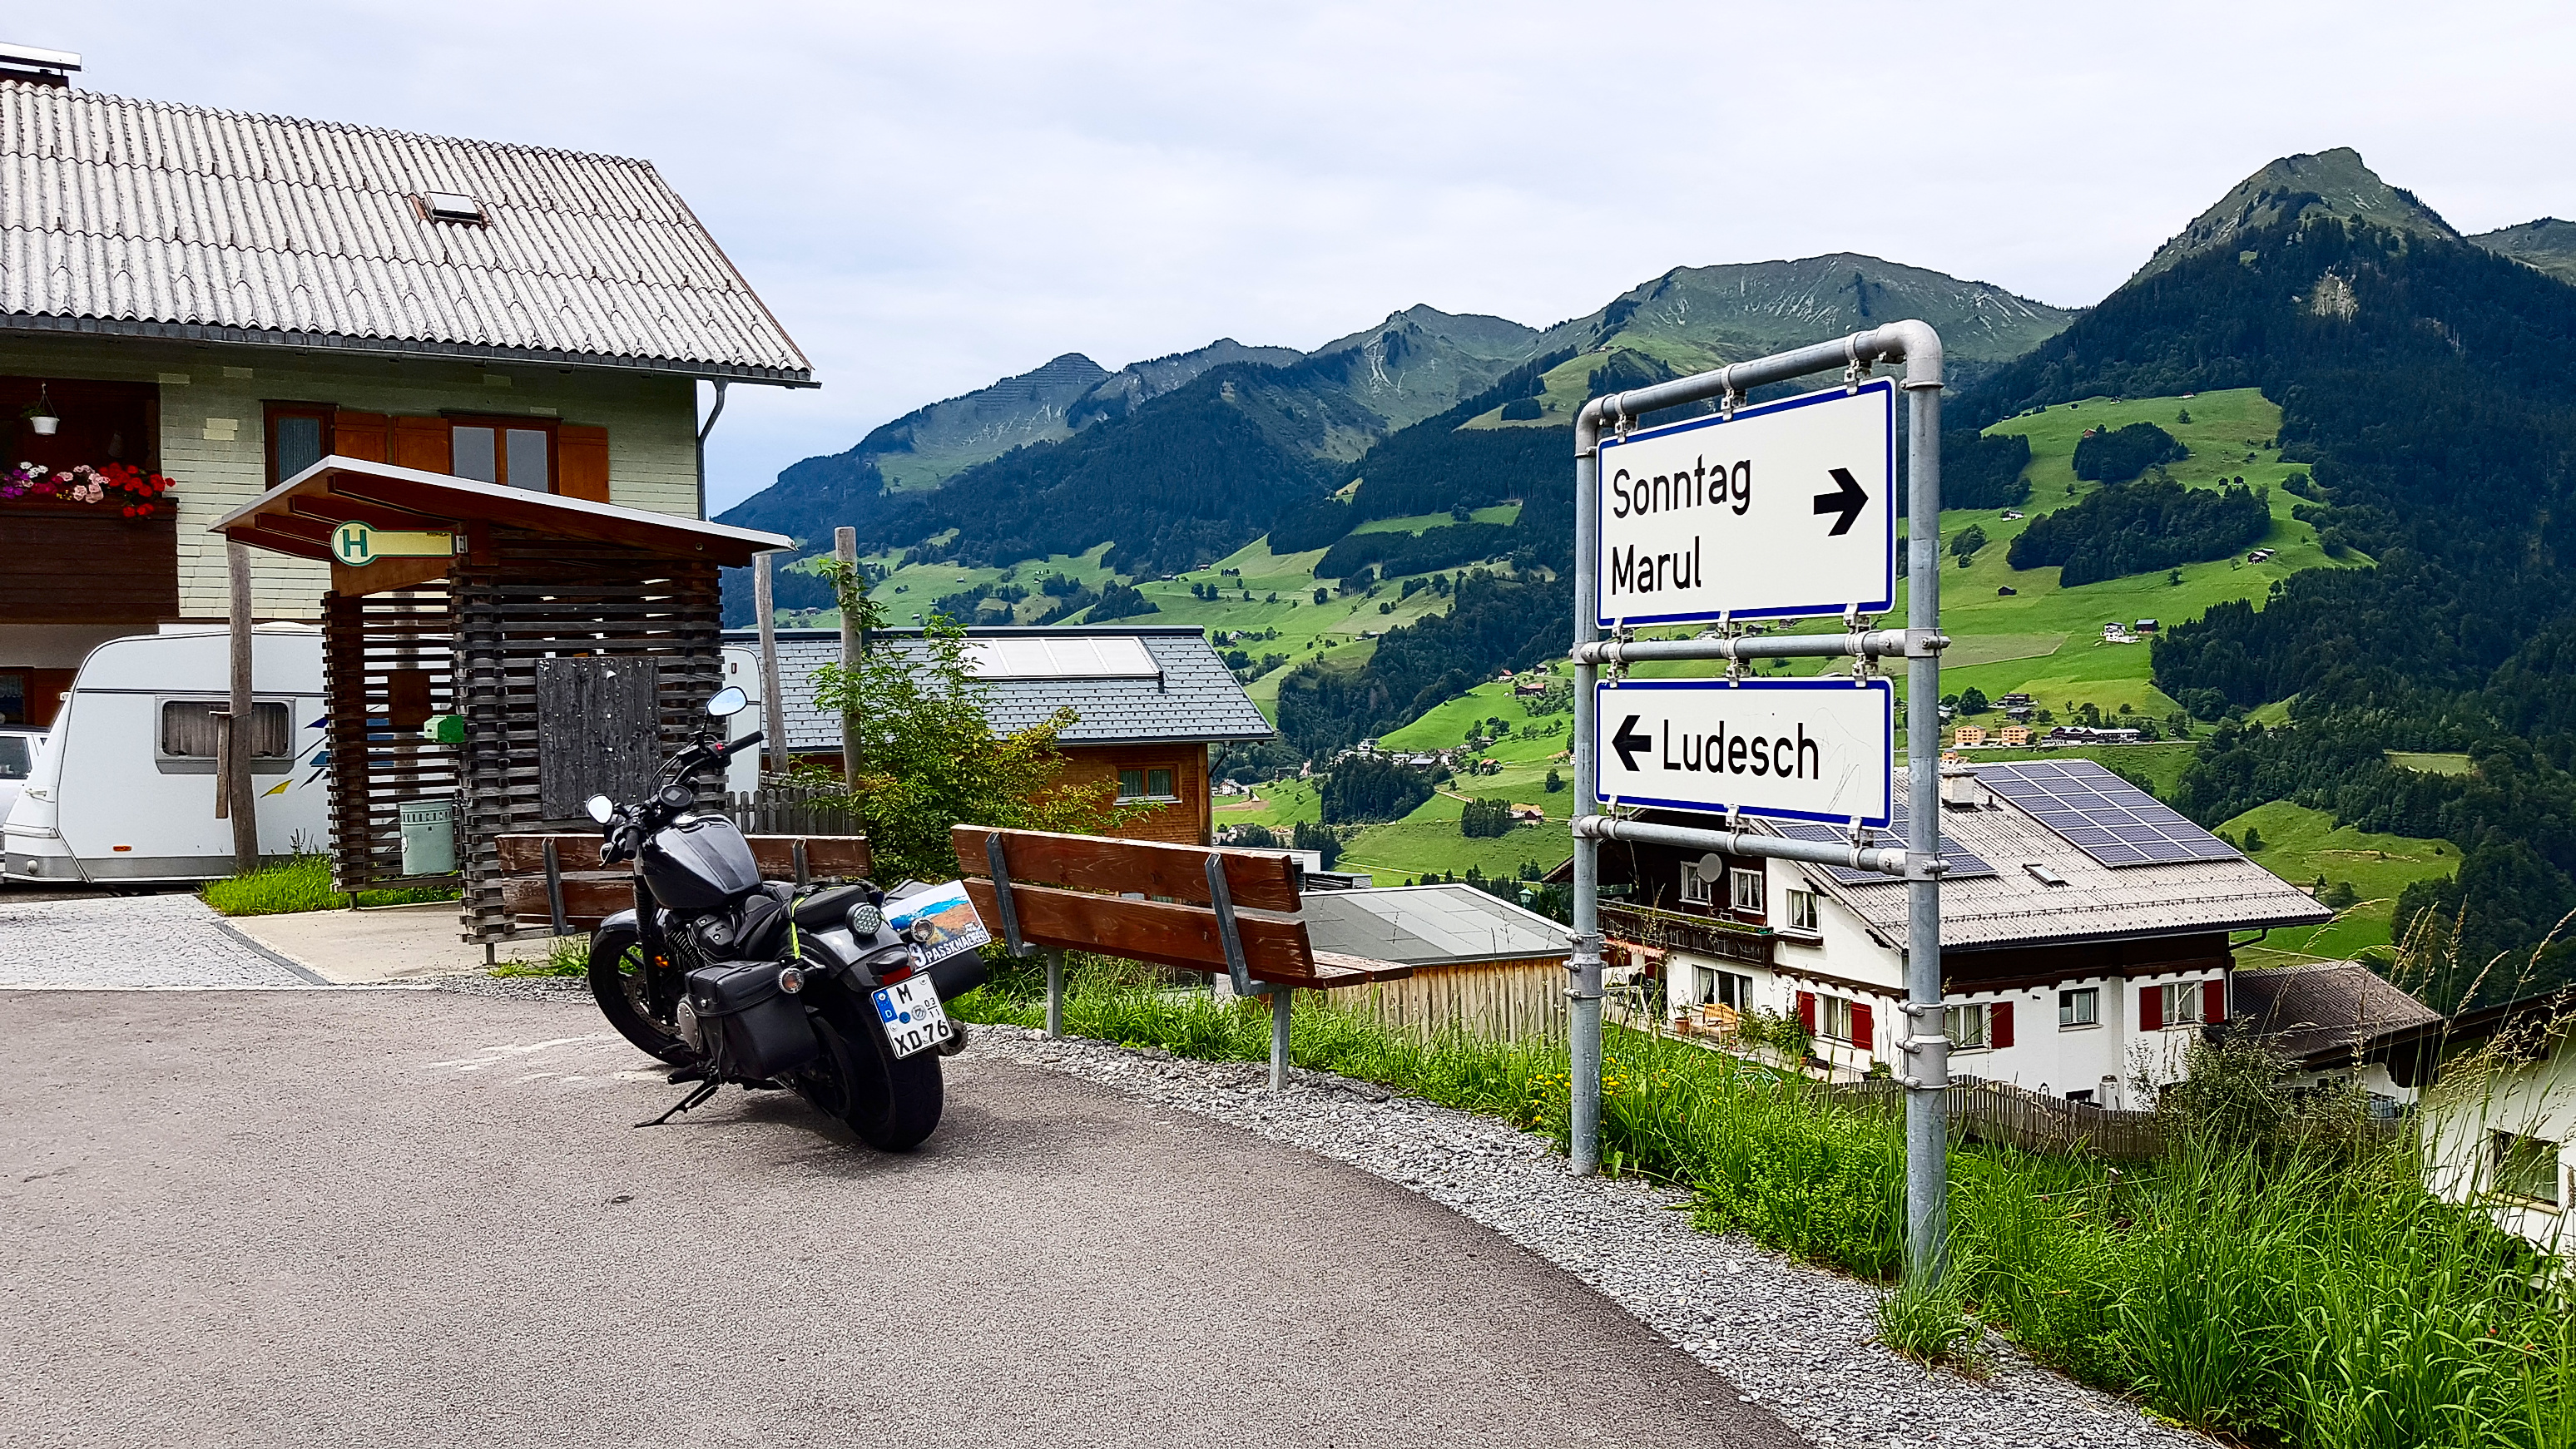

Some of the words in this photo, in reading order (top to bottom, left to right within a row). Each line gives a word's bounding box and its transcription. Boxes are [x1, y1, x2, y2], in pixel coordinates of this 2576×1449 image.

[1612, 453, 1751, 519] Sonntag
[342, 529, 368, 556] H
[1612, 536, 1702, 595] Marul
[1663, 719, 1819, 780] Ludesch
[925, 931, 988, 963] PASSKNACKER
[896, 983, 913, 1004] M
[924, 997, 936, 1007] 03
[884, 1009, 893, 1019] D
